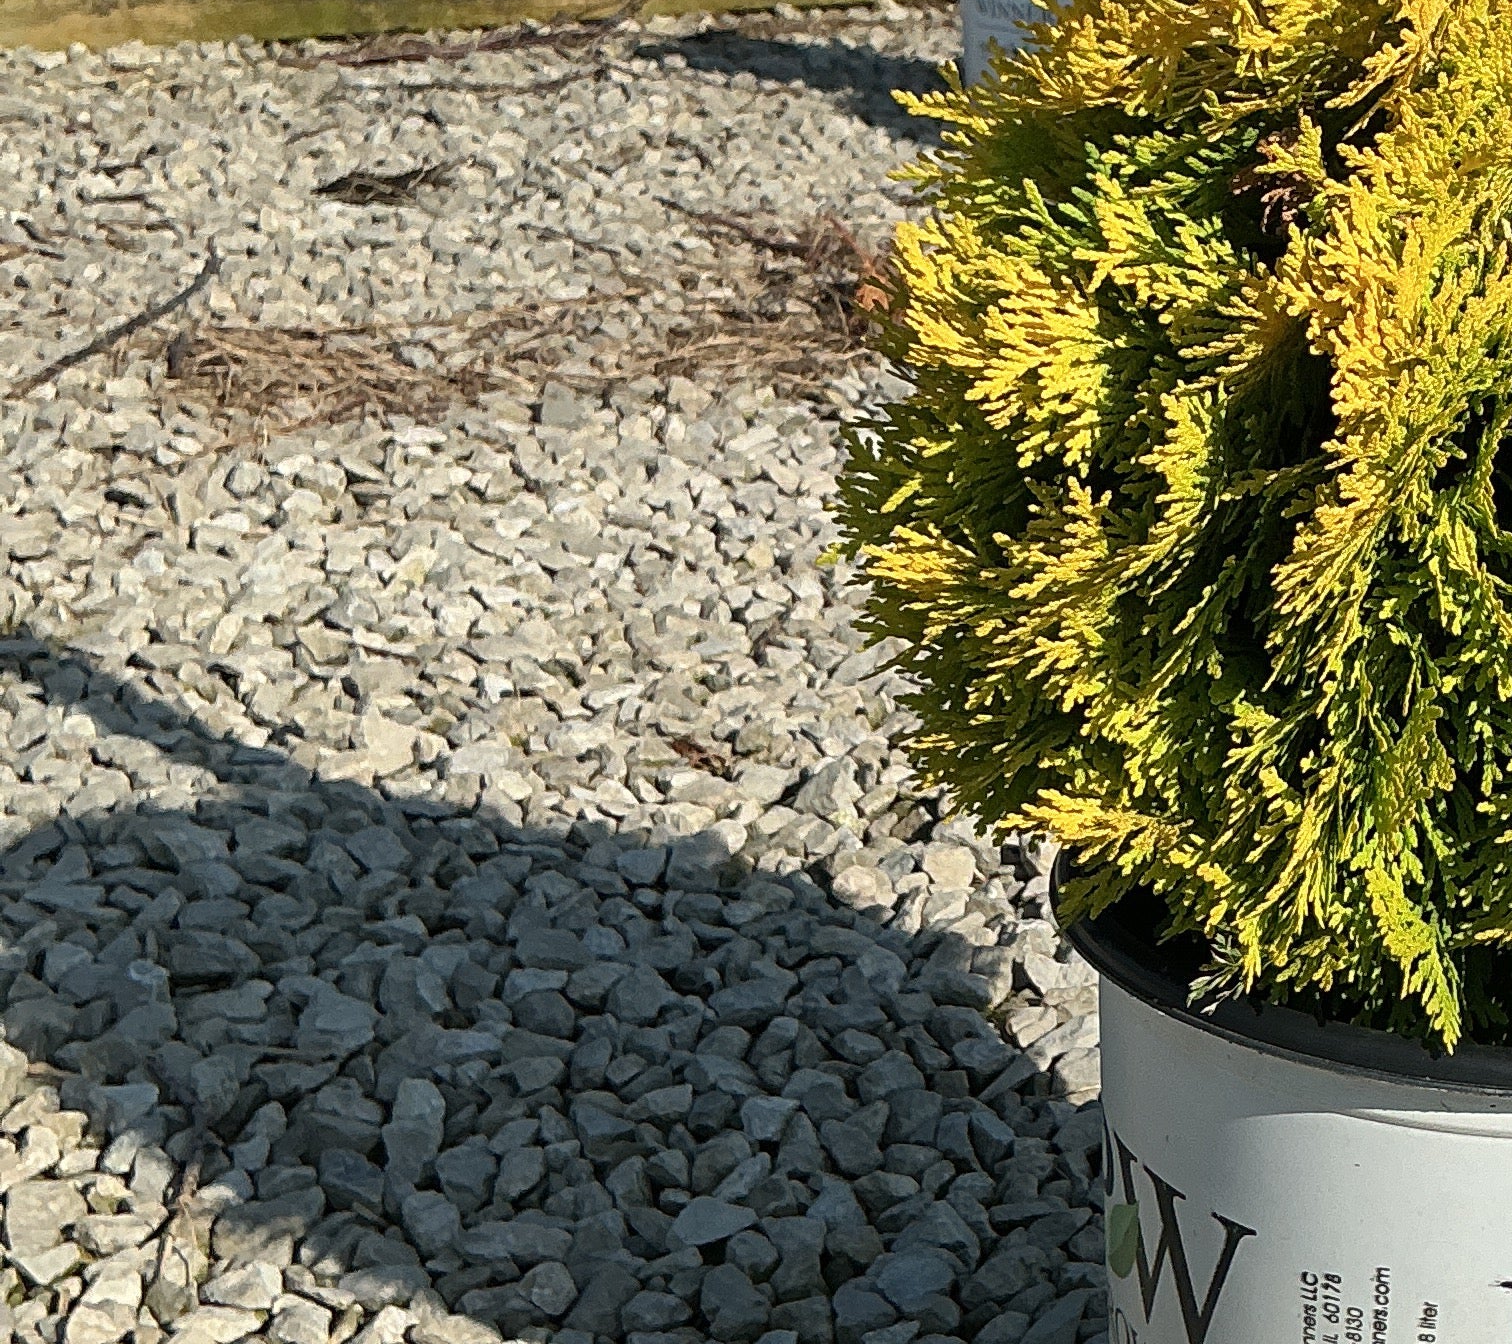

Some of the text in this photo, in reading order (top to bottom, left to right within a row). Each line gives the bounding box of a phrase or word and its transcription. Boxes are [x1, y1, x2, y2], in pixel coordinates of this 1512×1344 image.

[1300, 1271, 1319, 1302] LLC
[1321, 1273, 1342, 1324] 60178
[1418, 1301, 1439, 1330] liter
